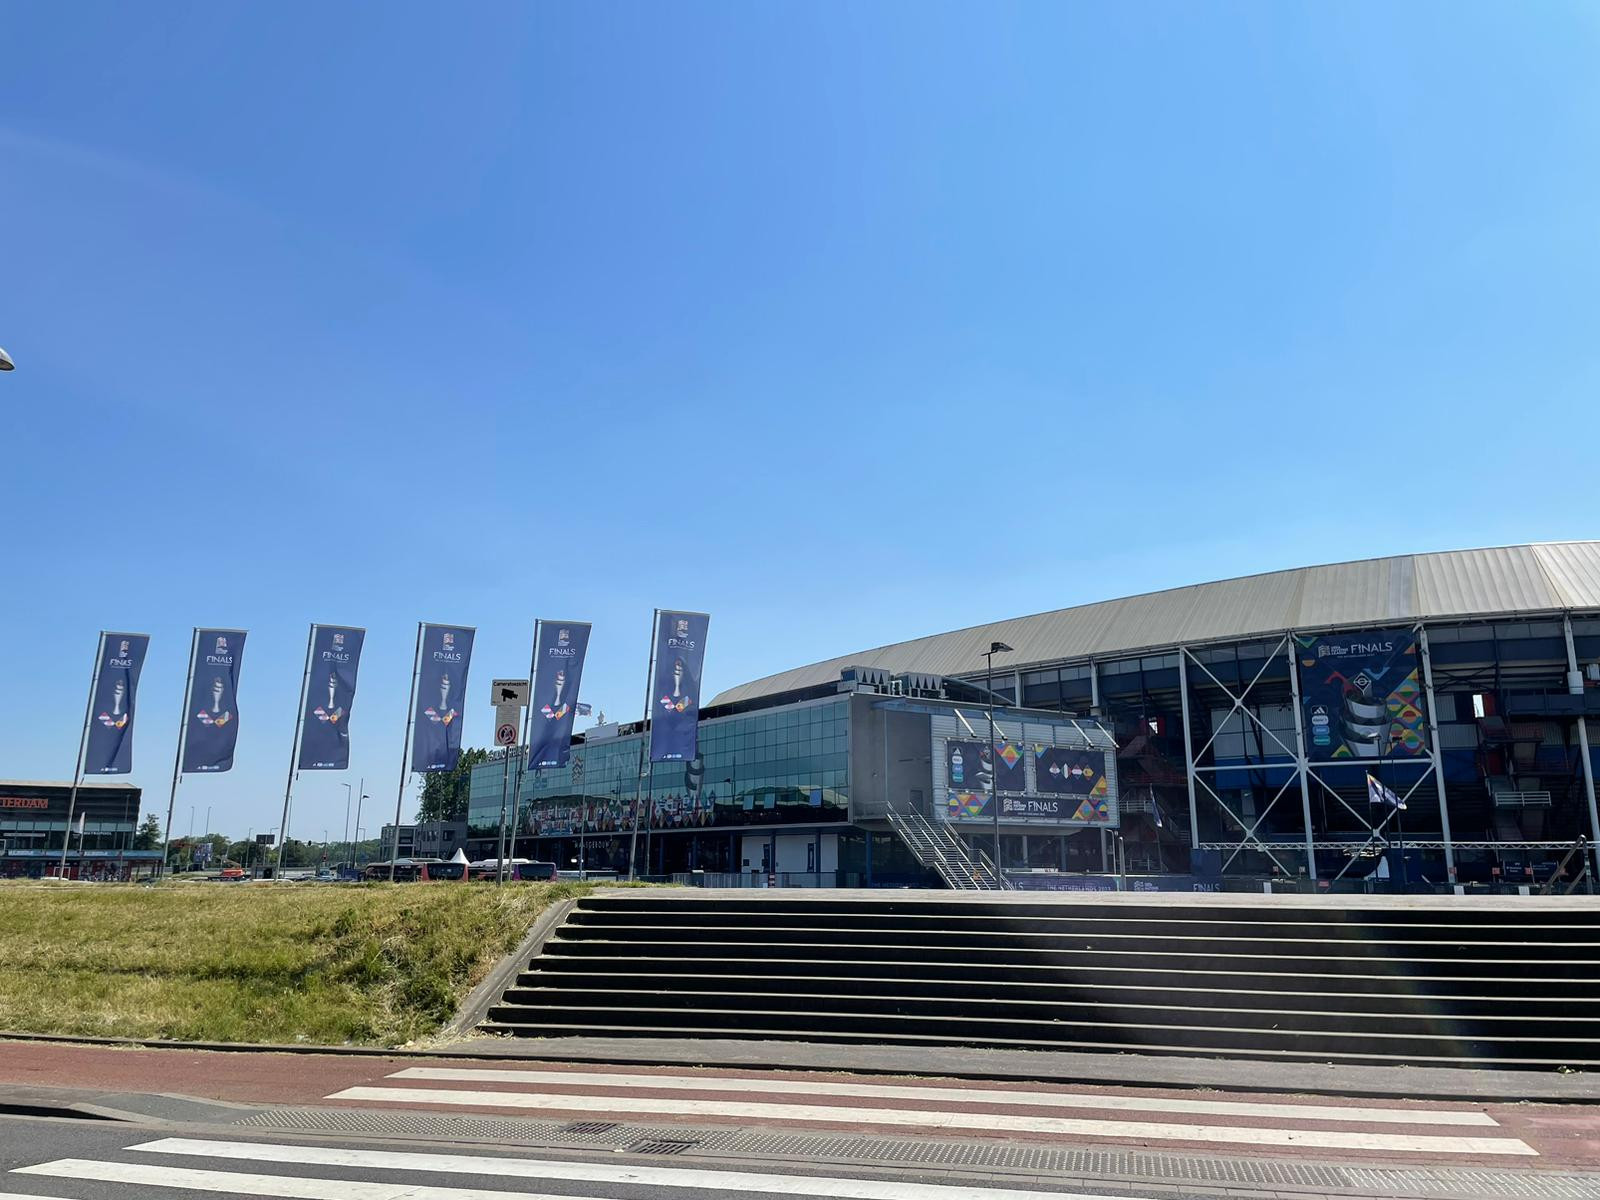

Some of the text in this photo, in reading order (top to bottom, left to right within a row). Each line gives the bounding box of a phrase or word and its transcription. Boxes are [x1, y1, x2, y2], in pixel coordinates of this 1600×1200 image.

[668, 638, 695, 649] FINALS
[1350, 641, 1393, 654] FINALS
[322, 651, 349, 661] FINALS
[433, 651, 461, 661] FINALS
[549, 647, 576, 656] FINALS
[206, 655, 233, 664] FINALS
[1028, 800, 1059, 812] FINALS
[1193, 883, 1221, 892] FINALS
